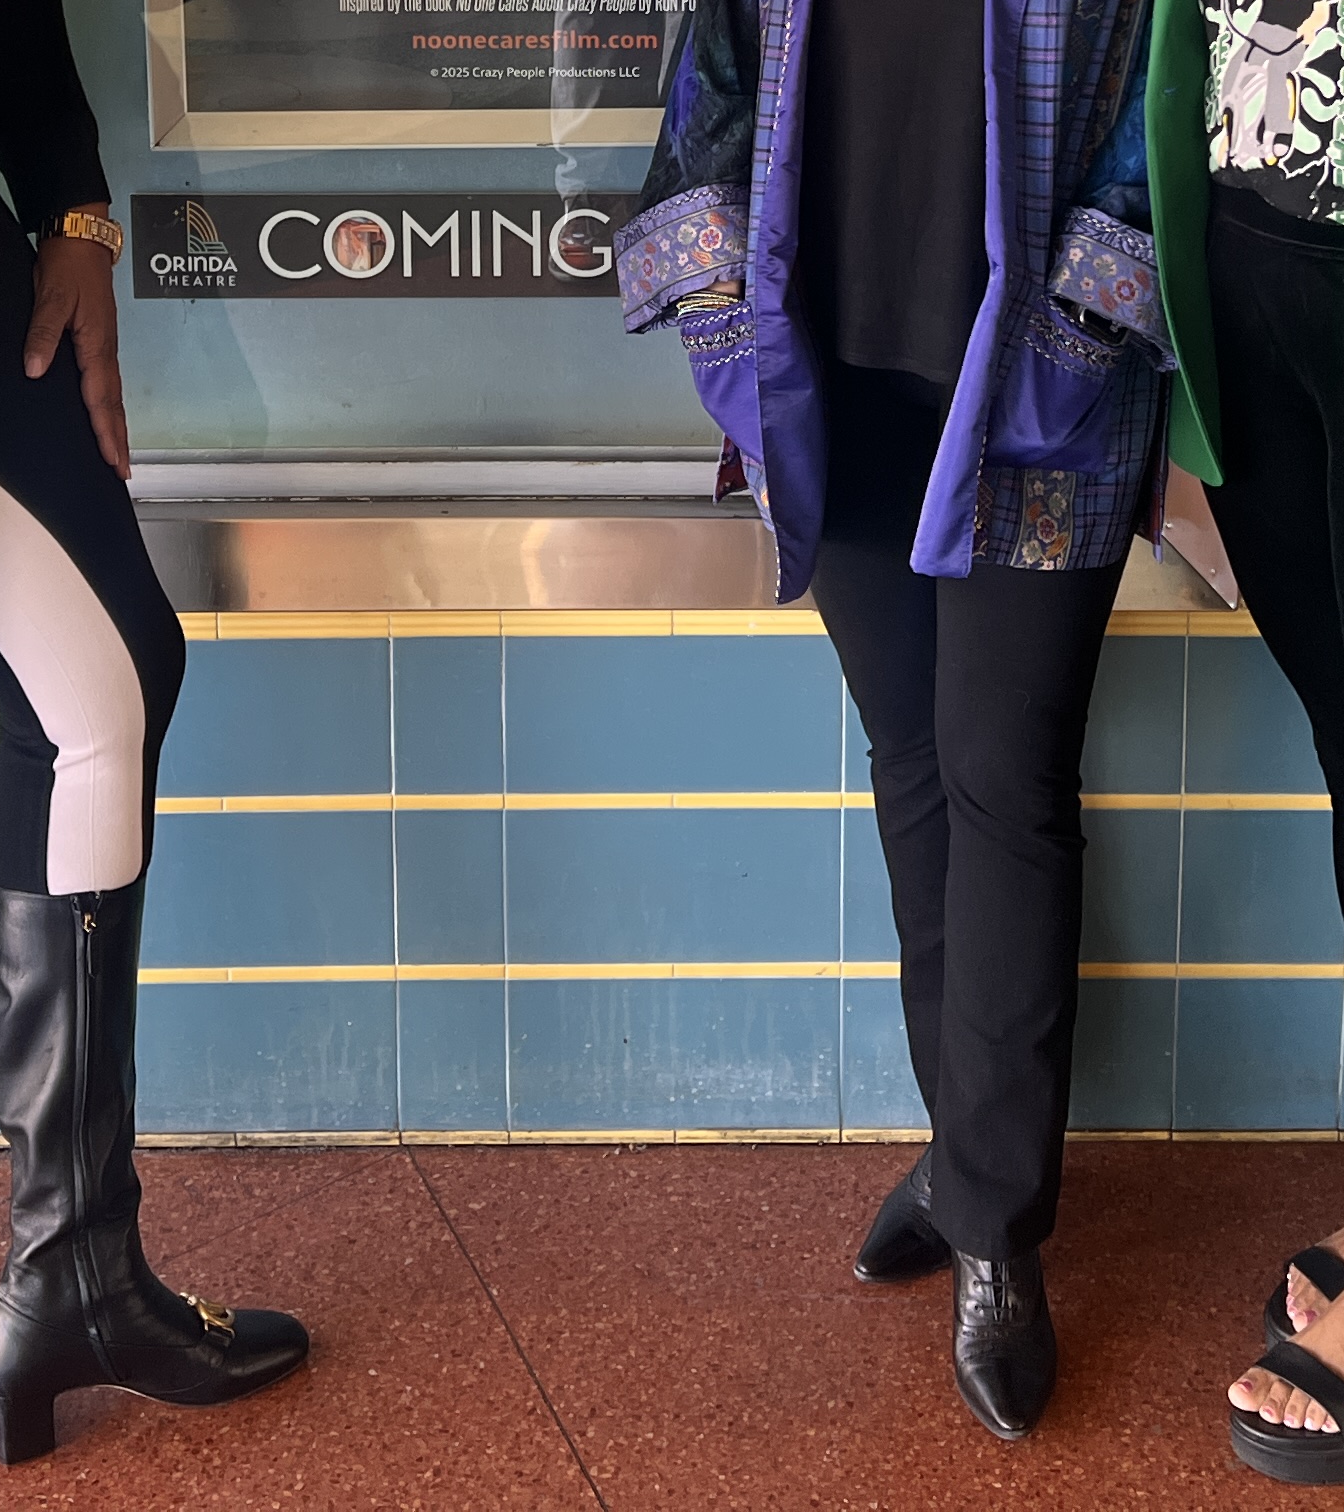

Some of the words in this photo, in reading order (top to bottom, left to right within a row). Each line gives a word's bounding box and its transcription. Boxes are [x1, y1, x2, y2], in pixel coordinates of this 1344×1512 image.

[412, 30, 658, 52] noonecaresfilm.com
[441, 67, 470, 78] 2025
[472, 67, 504, 80] Crazy
[506, 66, 545, 80] People
[548, 66, 616, 78] Productions
[619, 67, 640, 78] LLC
[258, 209, 613, 279] COMING
[150, 252, 238, 275] ORINDA
[158, 275, 237, 287] THEATRE
